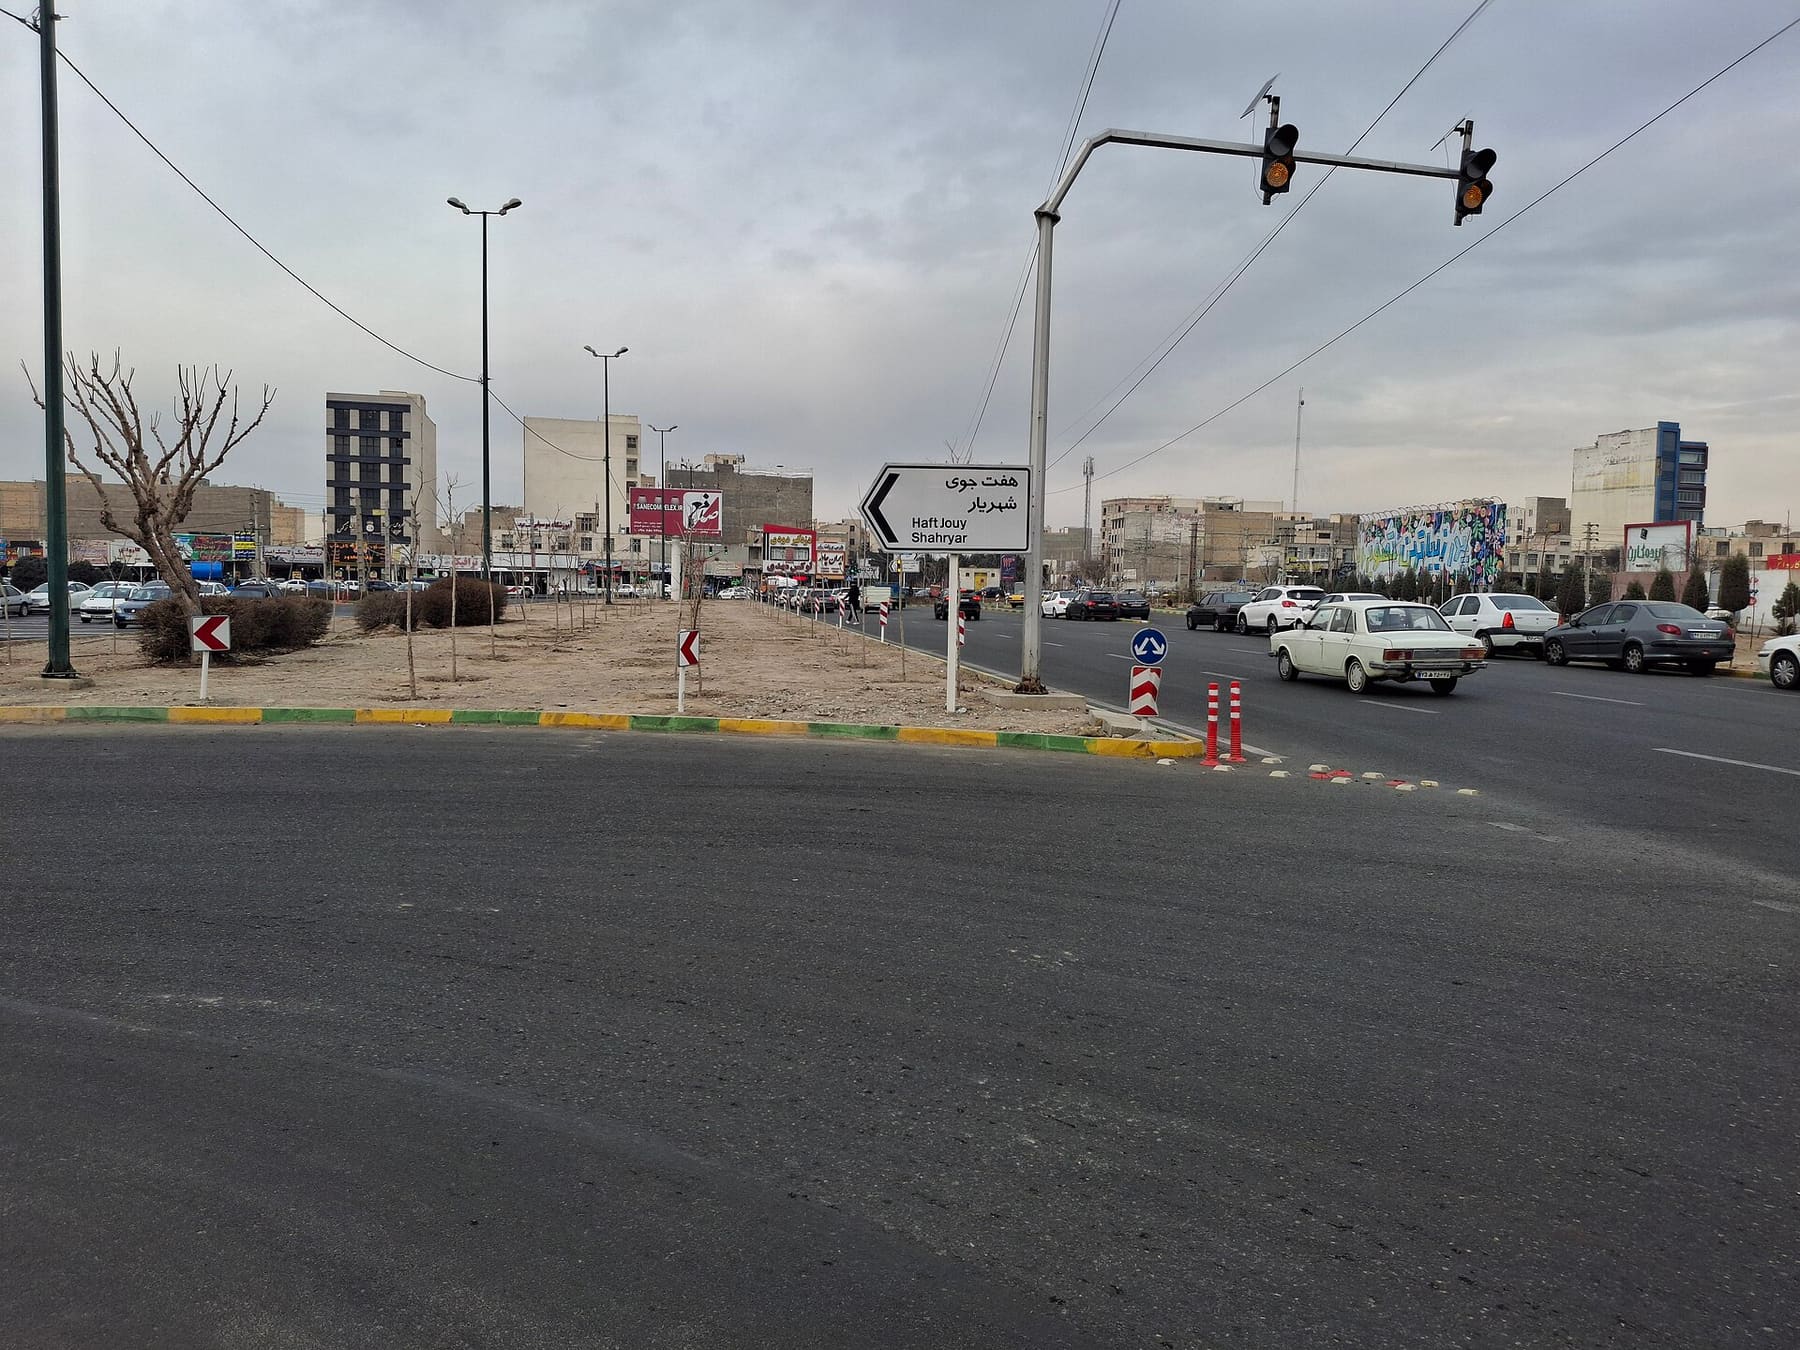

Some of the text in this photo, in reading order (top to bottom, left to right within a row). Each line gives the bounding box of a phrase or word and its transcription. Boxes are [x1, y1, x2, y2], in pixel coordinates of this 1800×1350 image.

[945, 474, 1019, 493] هفت جوی
[967, 496, 1017, 513] شهریار
[912, 517, 967, 530] Haft Jouy
[911, 532, 968, 545] Shahryar
